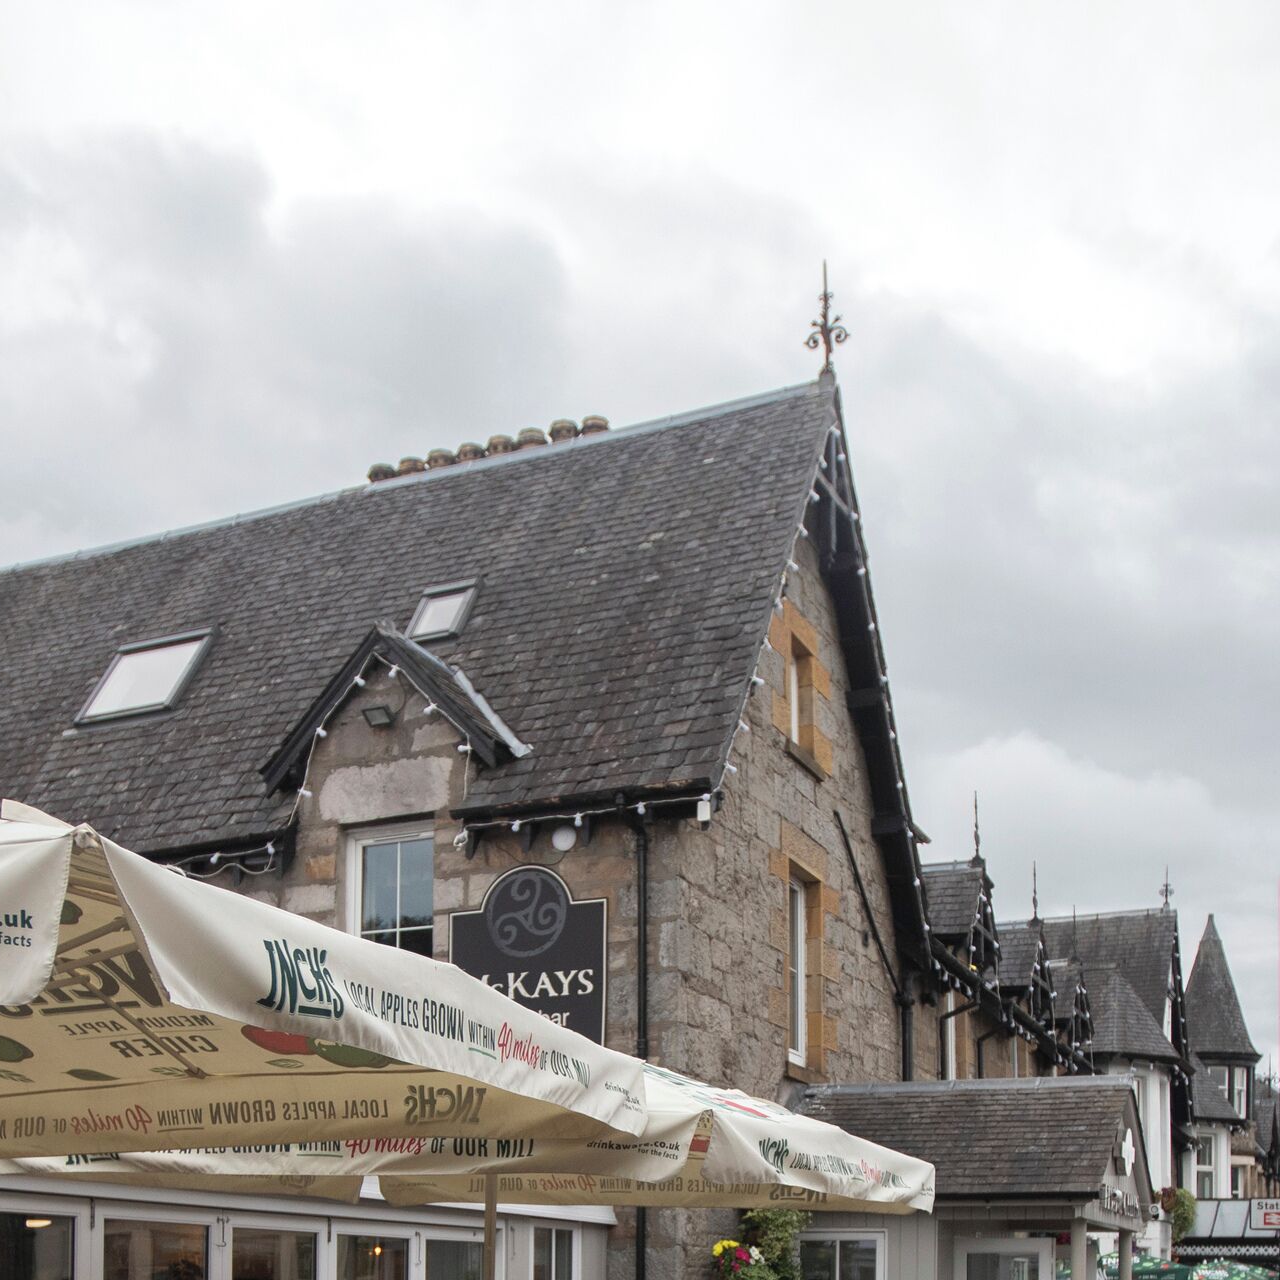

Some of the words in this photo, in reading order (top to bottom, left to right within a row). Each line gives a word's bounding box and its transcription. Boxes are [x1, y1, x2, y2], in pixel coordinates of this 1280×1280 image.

[256, 938, 345, 1020] INCH'S
[343, 979, 378, 1019] LOCAL
[380, 990, 419, 1030] APPLES
[422, 998, 465, 1043] GROWN
[468, 1018, 496, 1051] WITHIN
[498, 1022, 513, 1064] 40
[513, 1031, 541, 1070] miles
[539, 1050, 549, 1071] OF
[550, 1049, 574, 1080] OUR
[431, 1138, 446, 1153] OF
[453, 1138, 488, 1157] OUR
[496, 1138, 535, 1158] MILL
[650, 1148, 662, 1157] the
[663, 1150, 679, 1160] facts
